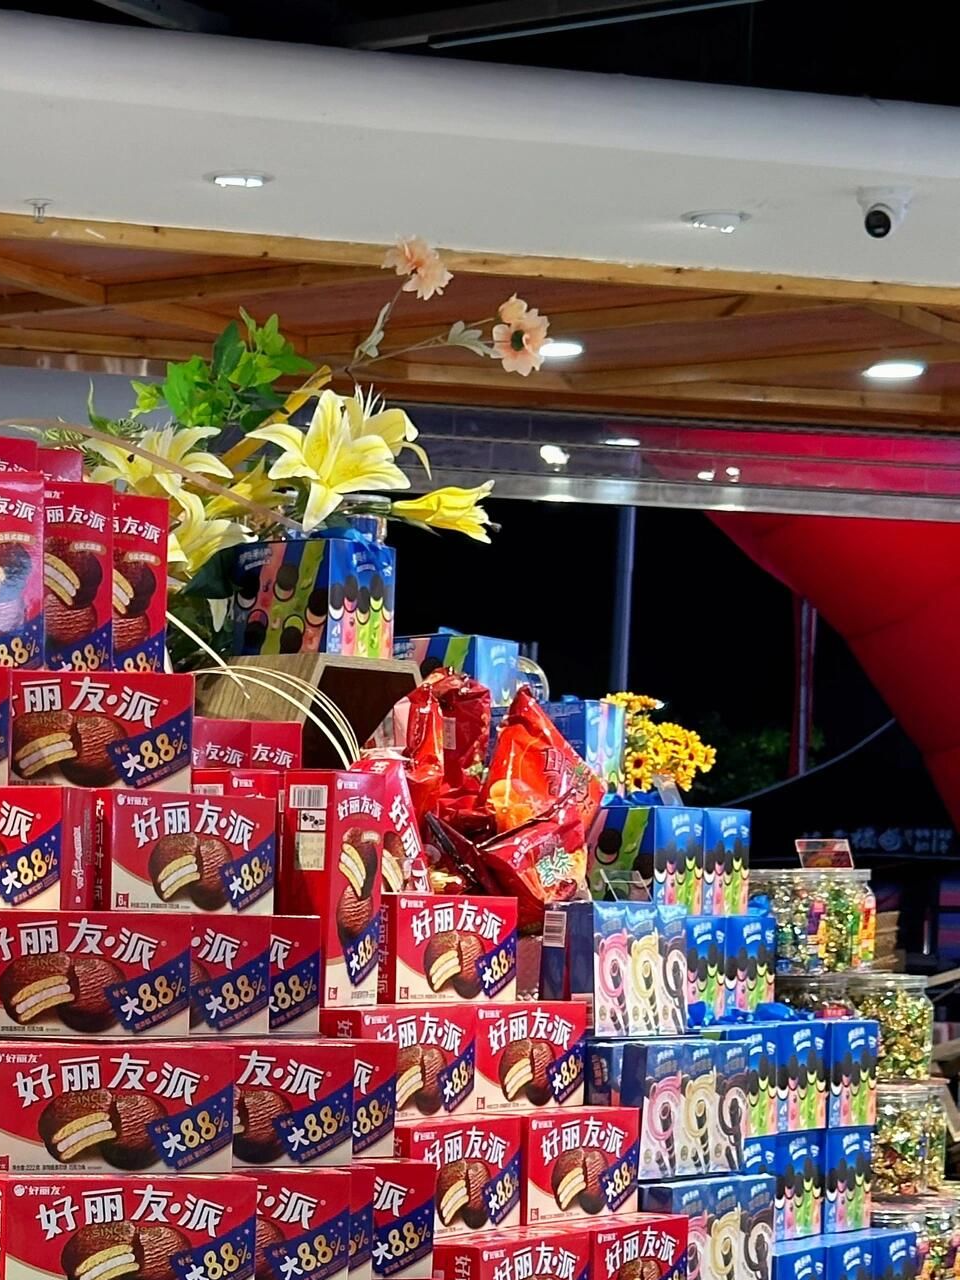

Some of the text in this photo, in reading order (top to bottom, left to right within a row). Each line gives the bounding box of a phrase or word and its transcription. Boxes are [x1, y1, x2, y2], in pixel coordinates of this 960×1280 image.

[46, 505, 105, 532] 丽友·派
[23, 673, 160, 728] 丽友·派
[127, 796, 255, 852] 好丽友·派
[411, 900, 502, 945] 好丽友·派
[488, 1009, 572, 1054] 好丽友·派
[13, 1053, 201, 1107] 好丽友·派
[541, 1116, 623, 1167] 好丽友·派
[35, 1184, 225, 1240] 好丽友·派
[605, 1226, 677, 1278] 好丽友·派
